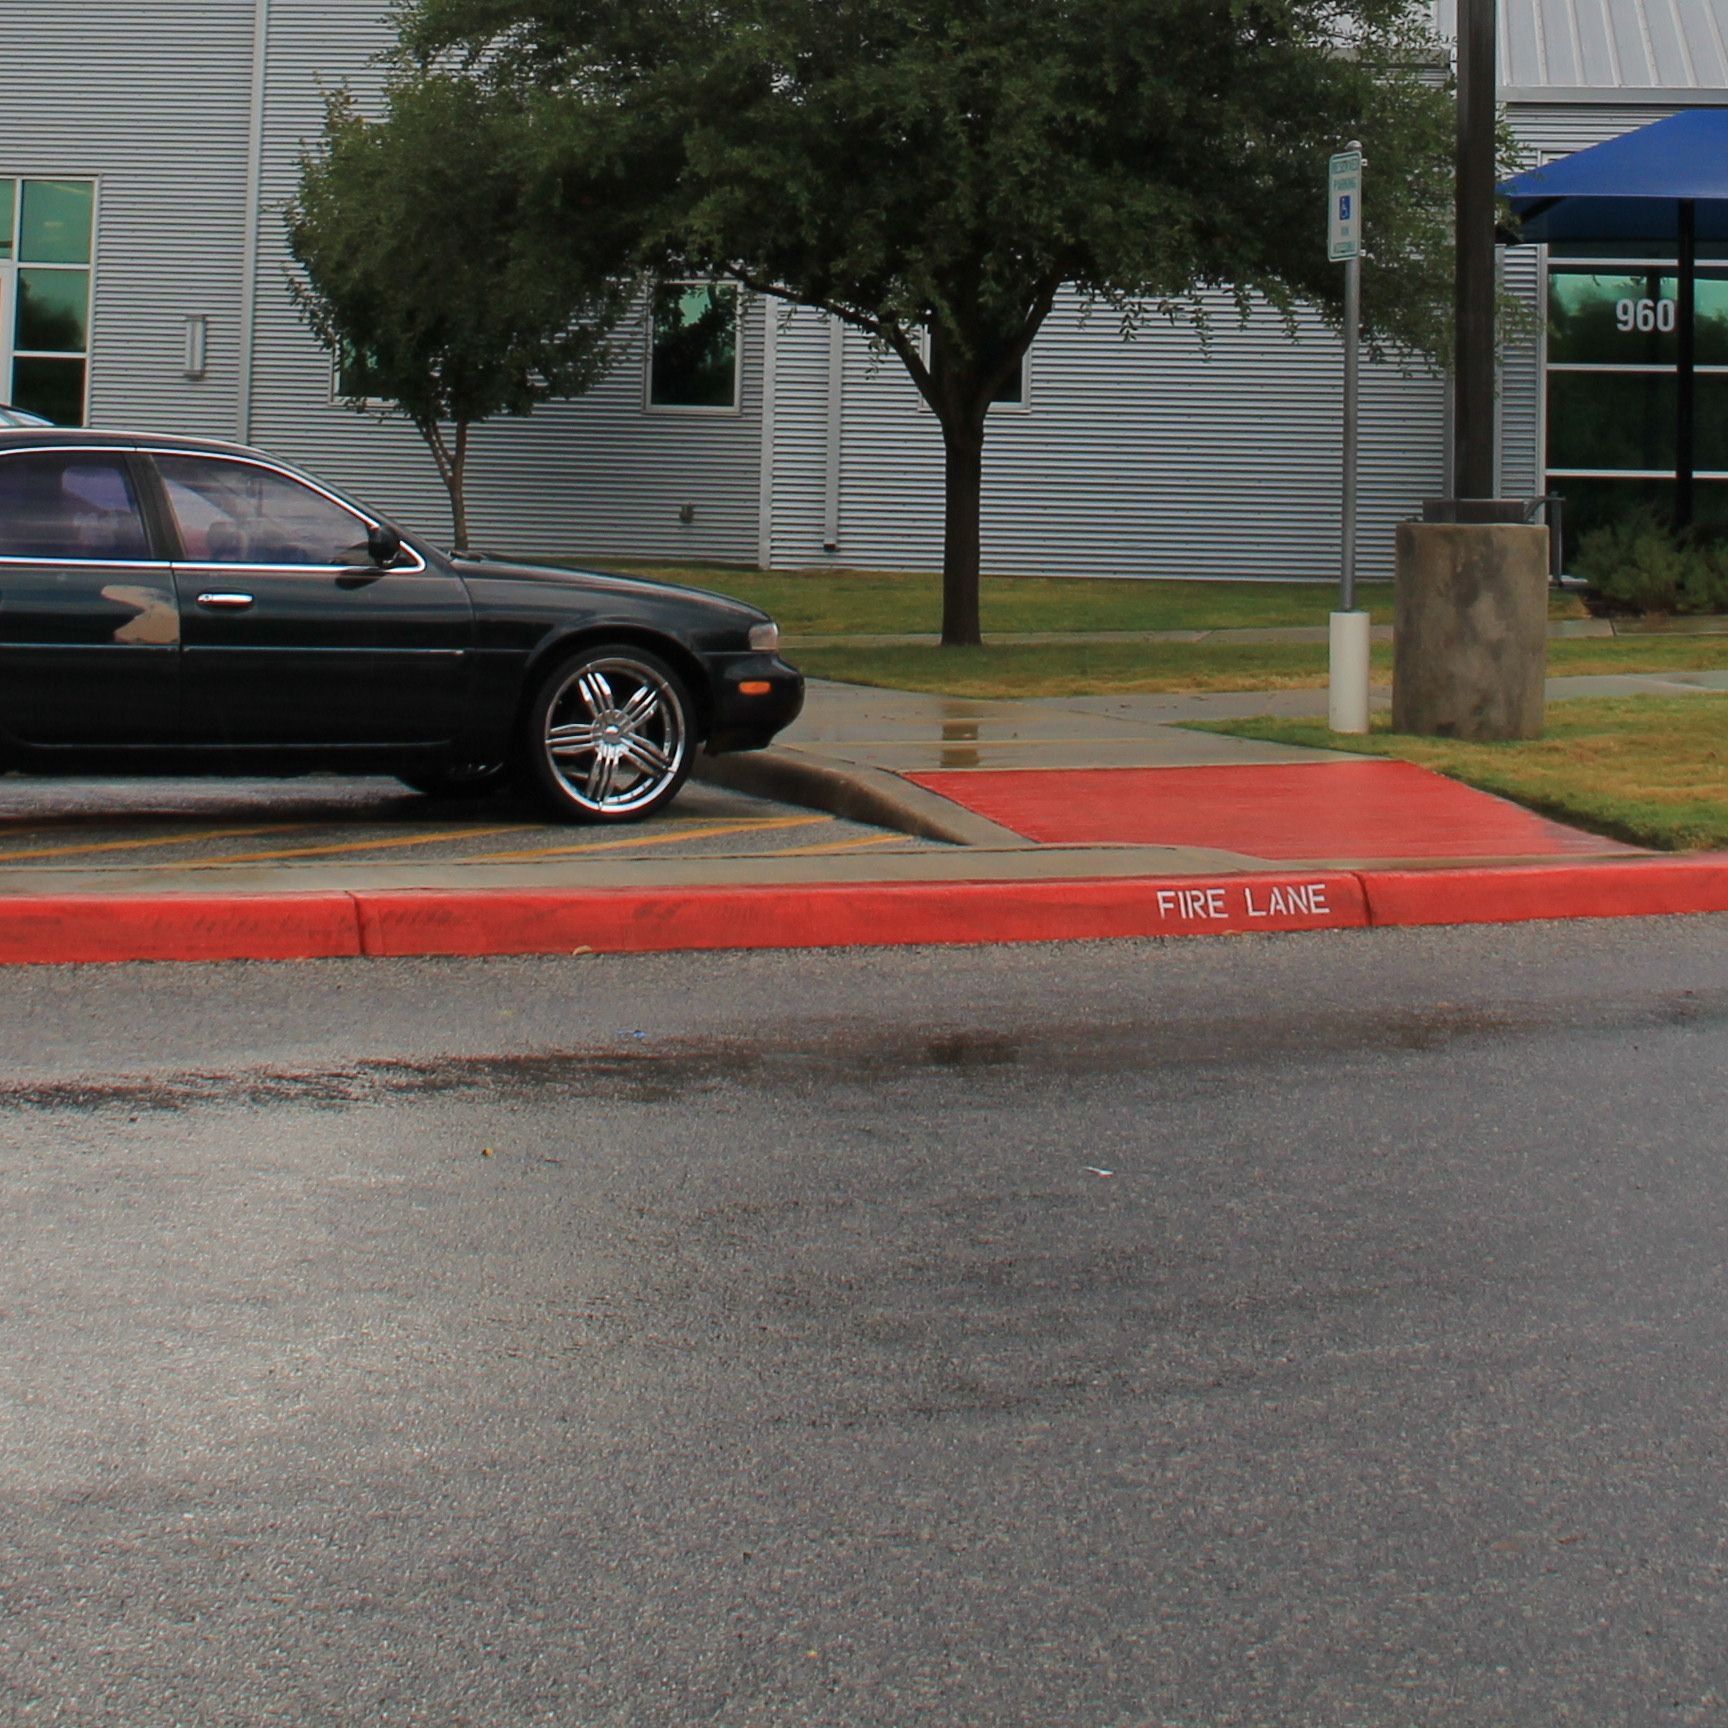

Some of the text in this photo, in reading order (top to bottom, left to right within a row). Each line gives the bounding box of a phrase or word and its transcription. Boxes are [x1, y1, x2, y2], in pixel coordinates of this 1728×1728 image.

[1615, 298, 1675, 332] 960
[1156, 884, 1331, 919] FIRE LANE
